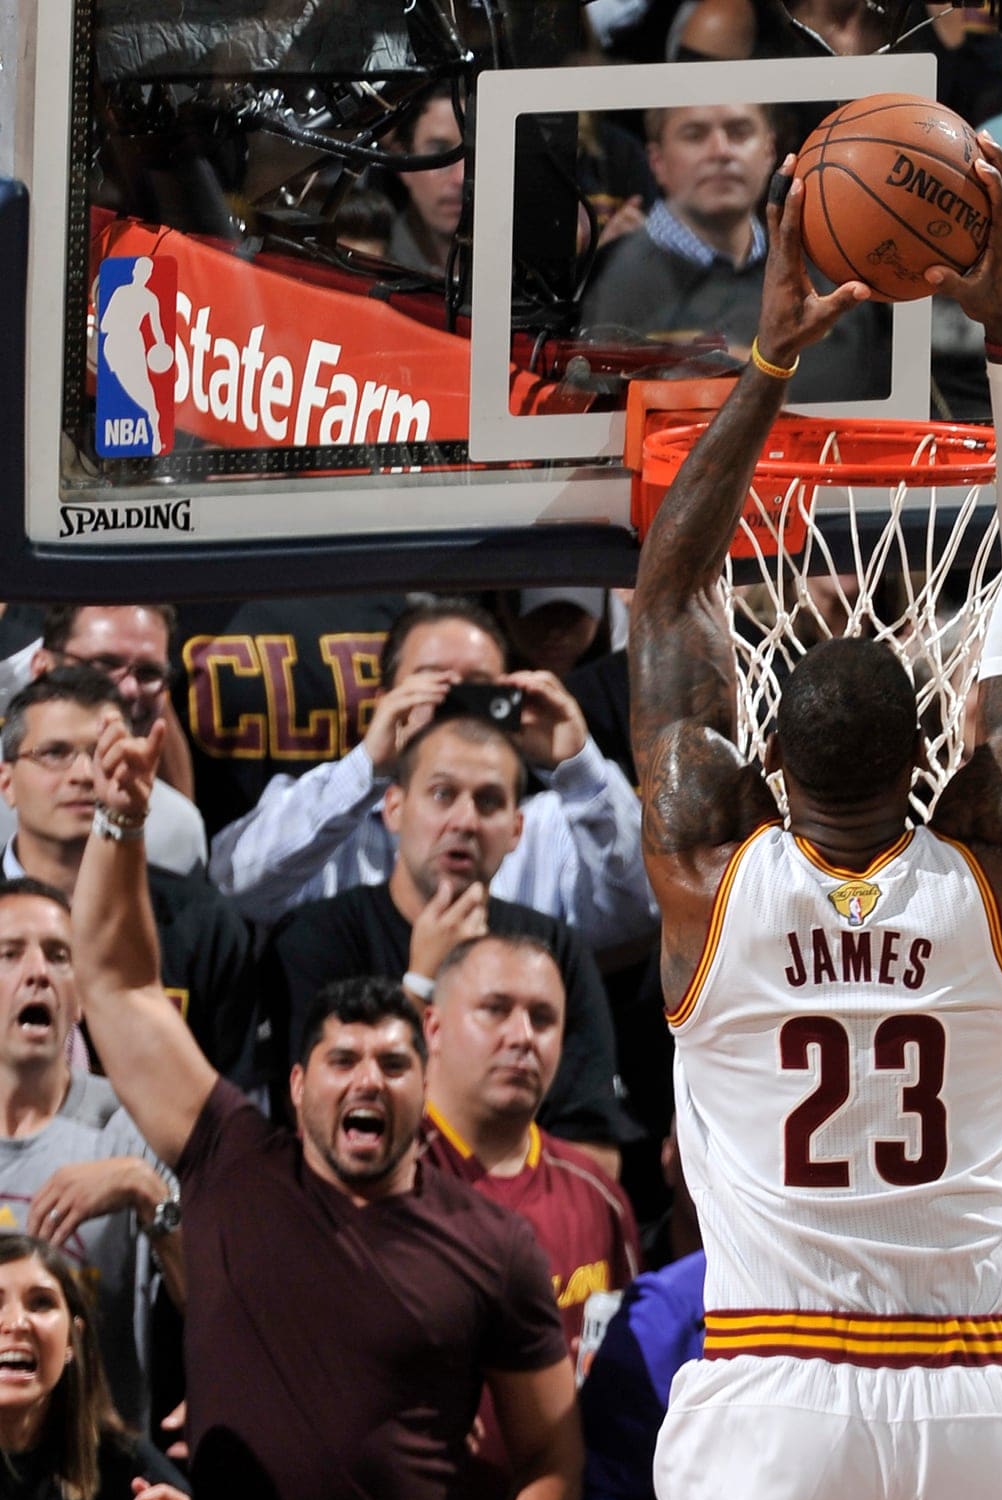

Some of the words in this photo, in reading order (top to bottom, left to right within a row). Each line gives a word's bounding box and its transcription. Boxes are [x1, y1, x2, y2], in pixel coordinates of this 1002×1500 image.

[885, 153, 992, 253] PALDING
[104, 418, 149, 447] NBA
[59, 499, 191, 538] SPALDING
[784, 927, 933, 990] JAMES
[778, 1013, 949, 1188] 23
